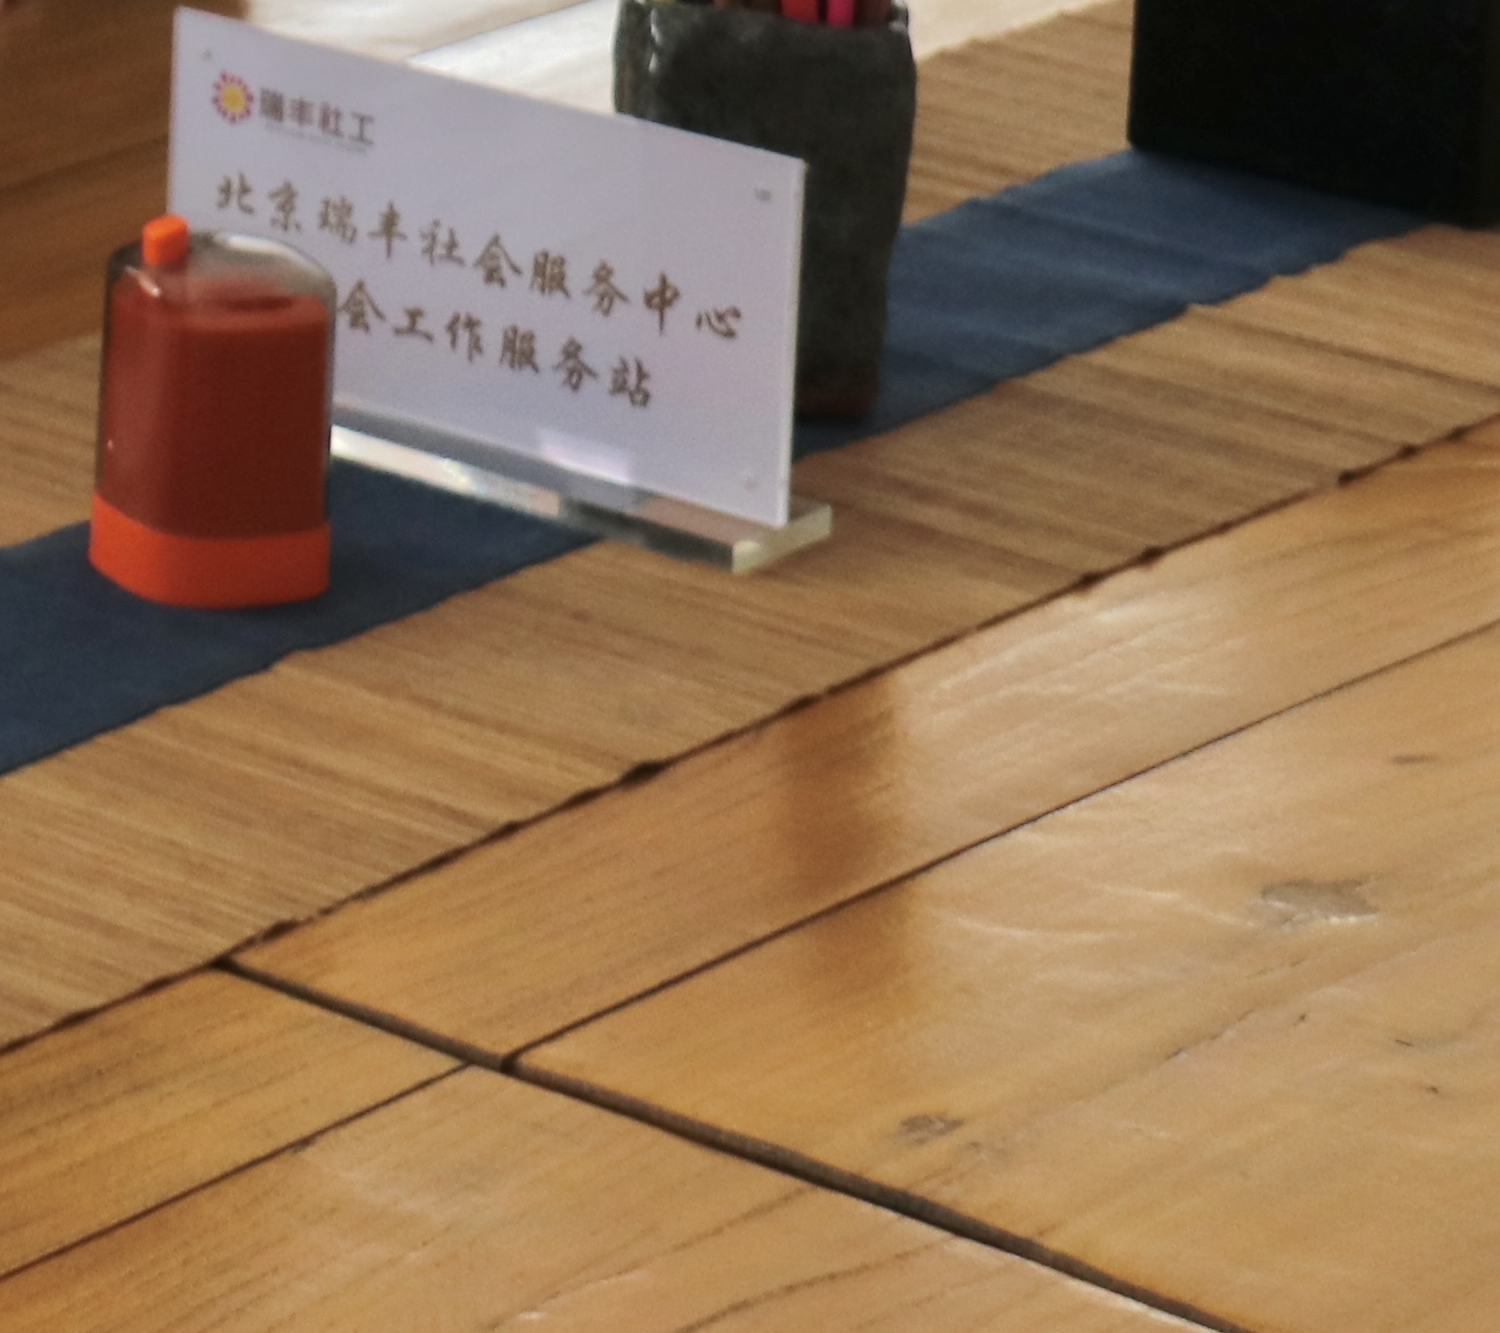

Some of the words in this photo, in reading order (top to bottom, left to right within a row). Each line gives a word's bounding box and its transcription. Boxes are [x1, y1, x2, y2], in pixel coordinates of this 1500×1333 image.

[216, 171, 743, 340] 北京瑞丰社会服务中心
[338, 278, 653, 408] 会工作服务站
